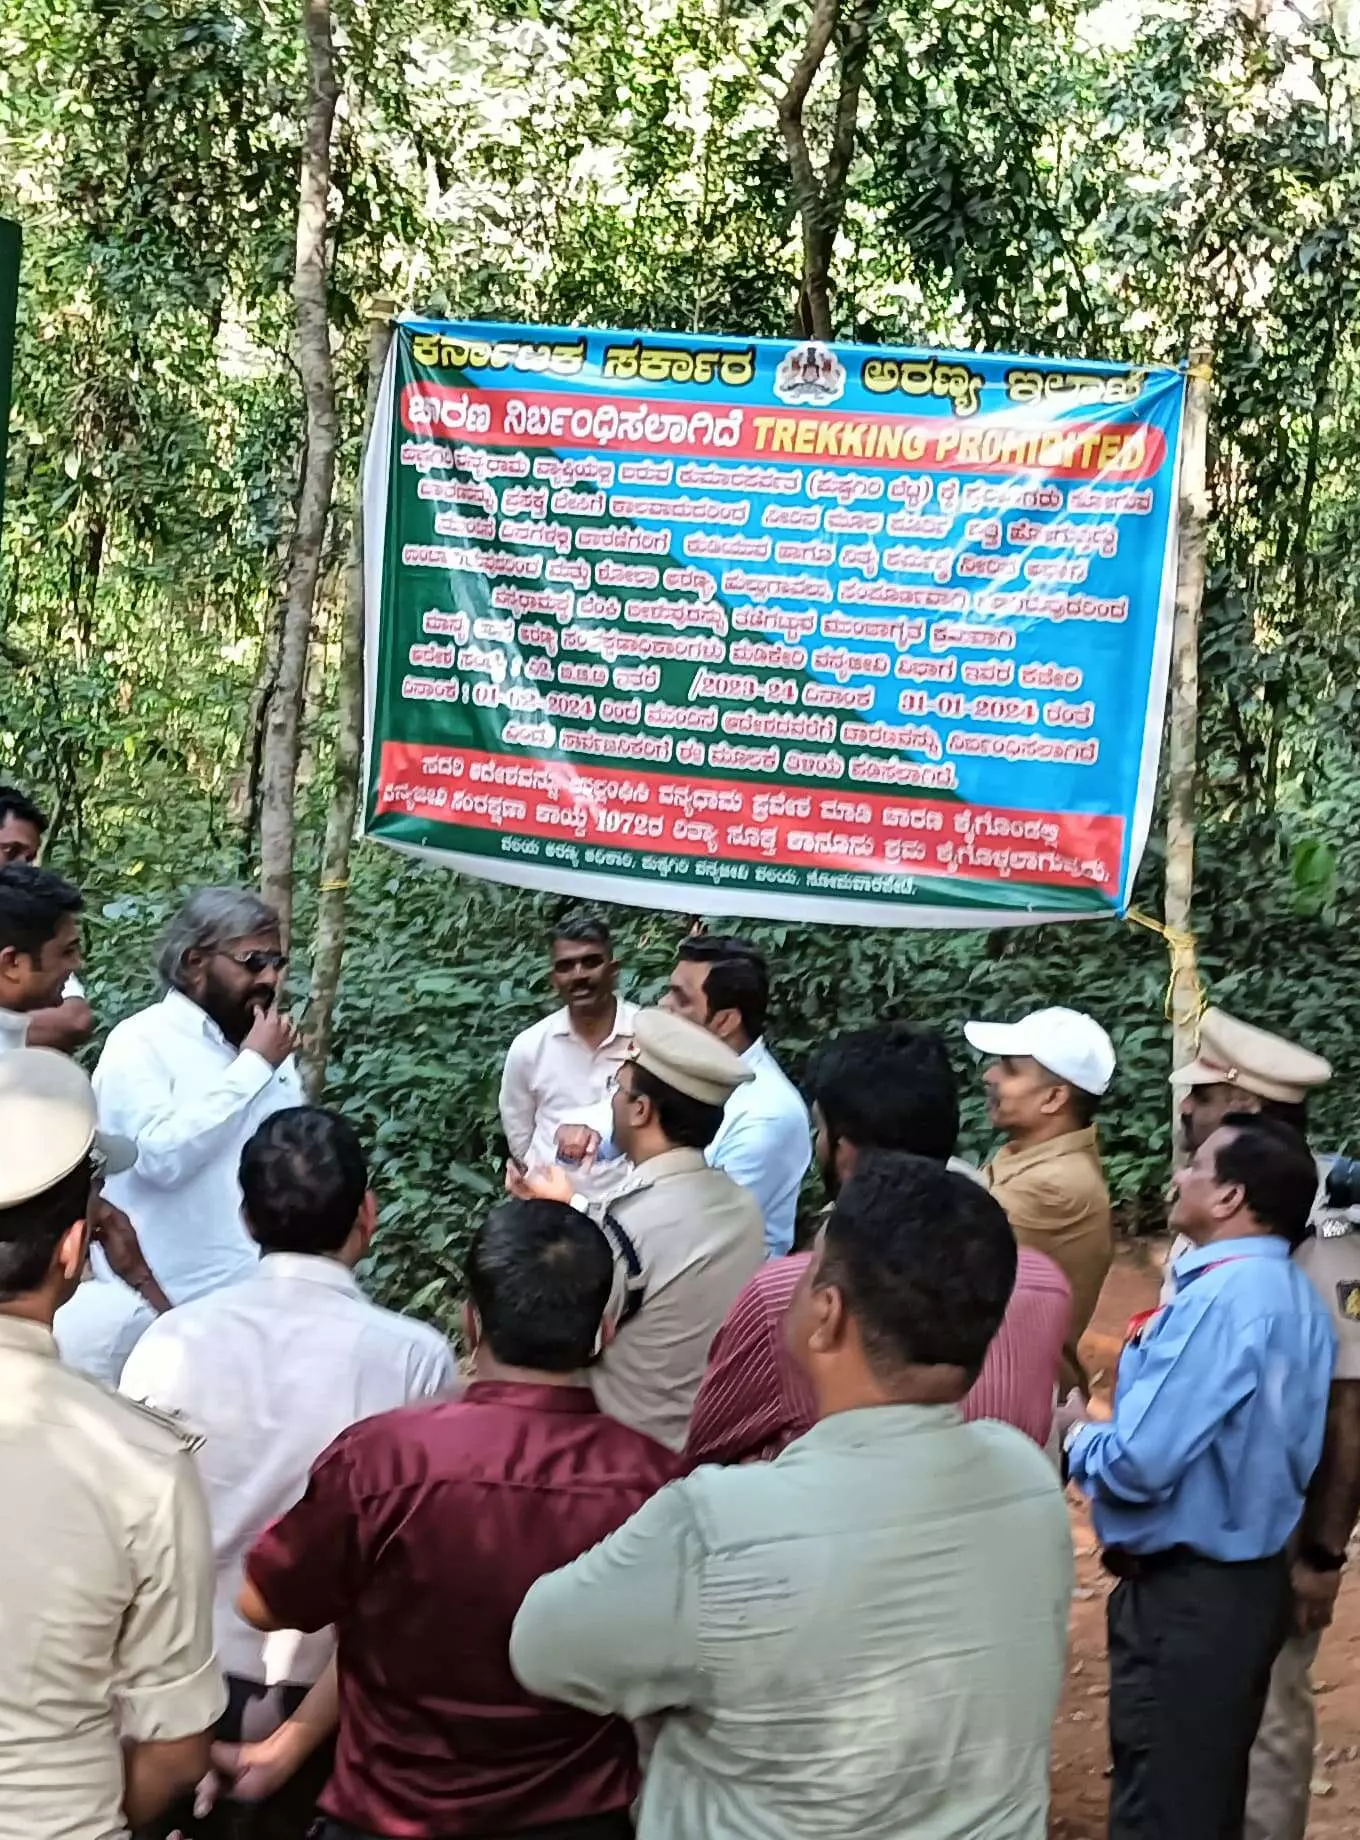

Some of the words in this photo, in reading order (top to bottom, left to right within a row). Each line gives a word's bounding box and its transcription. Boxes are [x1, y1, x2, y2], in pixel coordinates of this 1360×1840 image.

[604, 341, 754, 384] ಸರ್ಕಾರ
[863, 357, 983, 417] ಅರಣ್ಯ
[504, 399, 744, 447] ನಿರ್ಬಂಧಿಸಲಾಗಿದೆ
[753, 416, 927, 461] TREKKING
